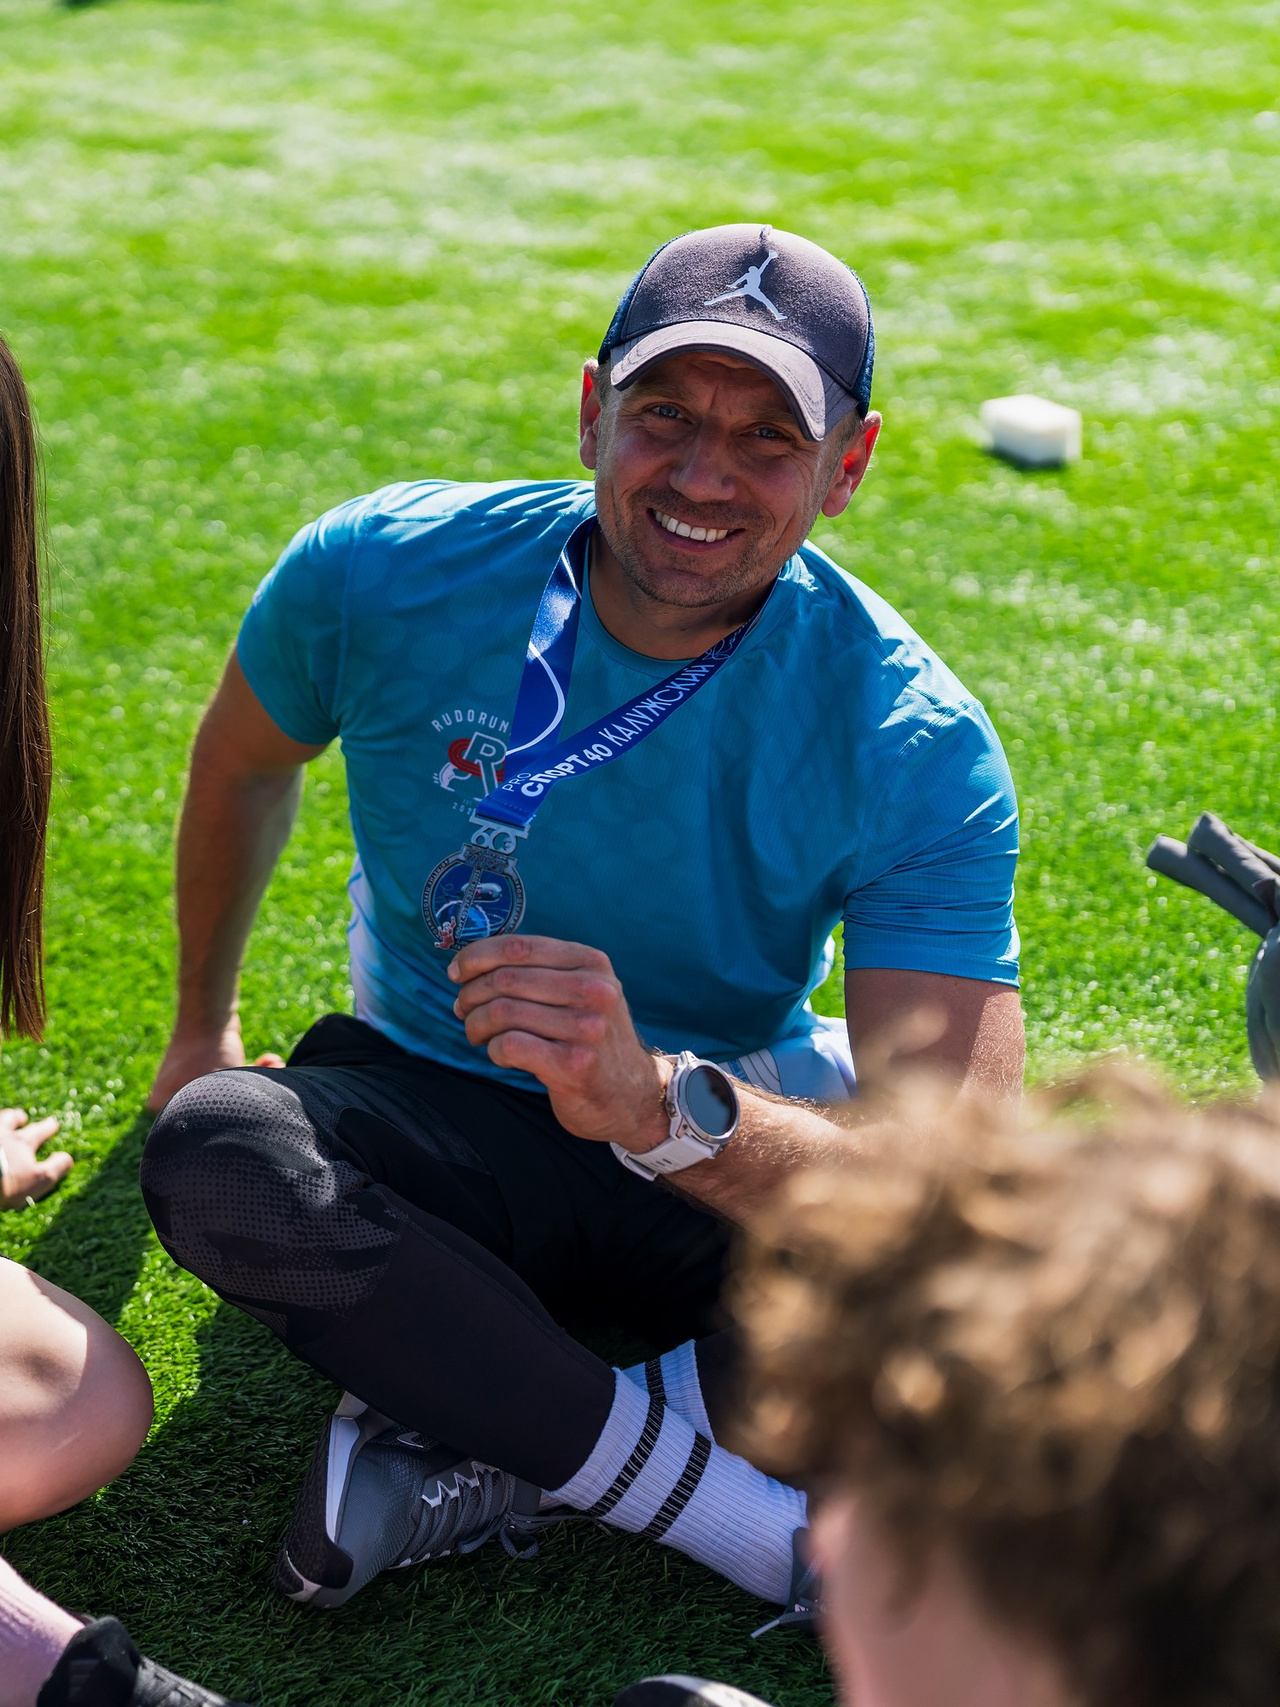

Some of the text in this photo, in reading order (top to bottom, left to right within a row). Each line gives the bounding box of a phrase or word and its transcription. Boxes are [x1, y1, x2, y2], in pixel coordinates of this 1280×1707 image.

[431, 709, 510, 734] RUDORUN
[521, 662, 715, 797] СПОРТ 40 КАЛУЖСКИЙ
[502, 772, 532, 792] PRO
[452, 802, 473, 815] 202
